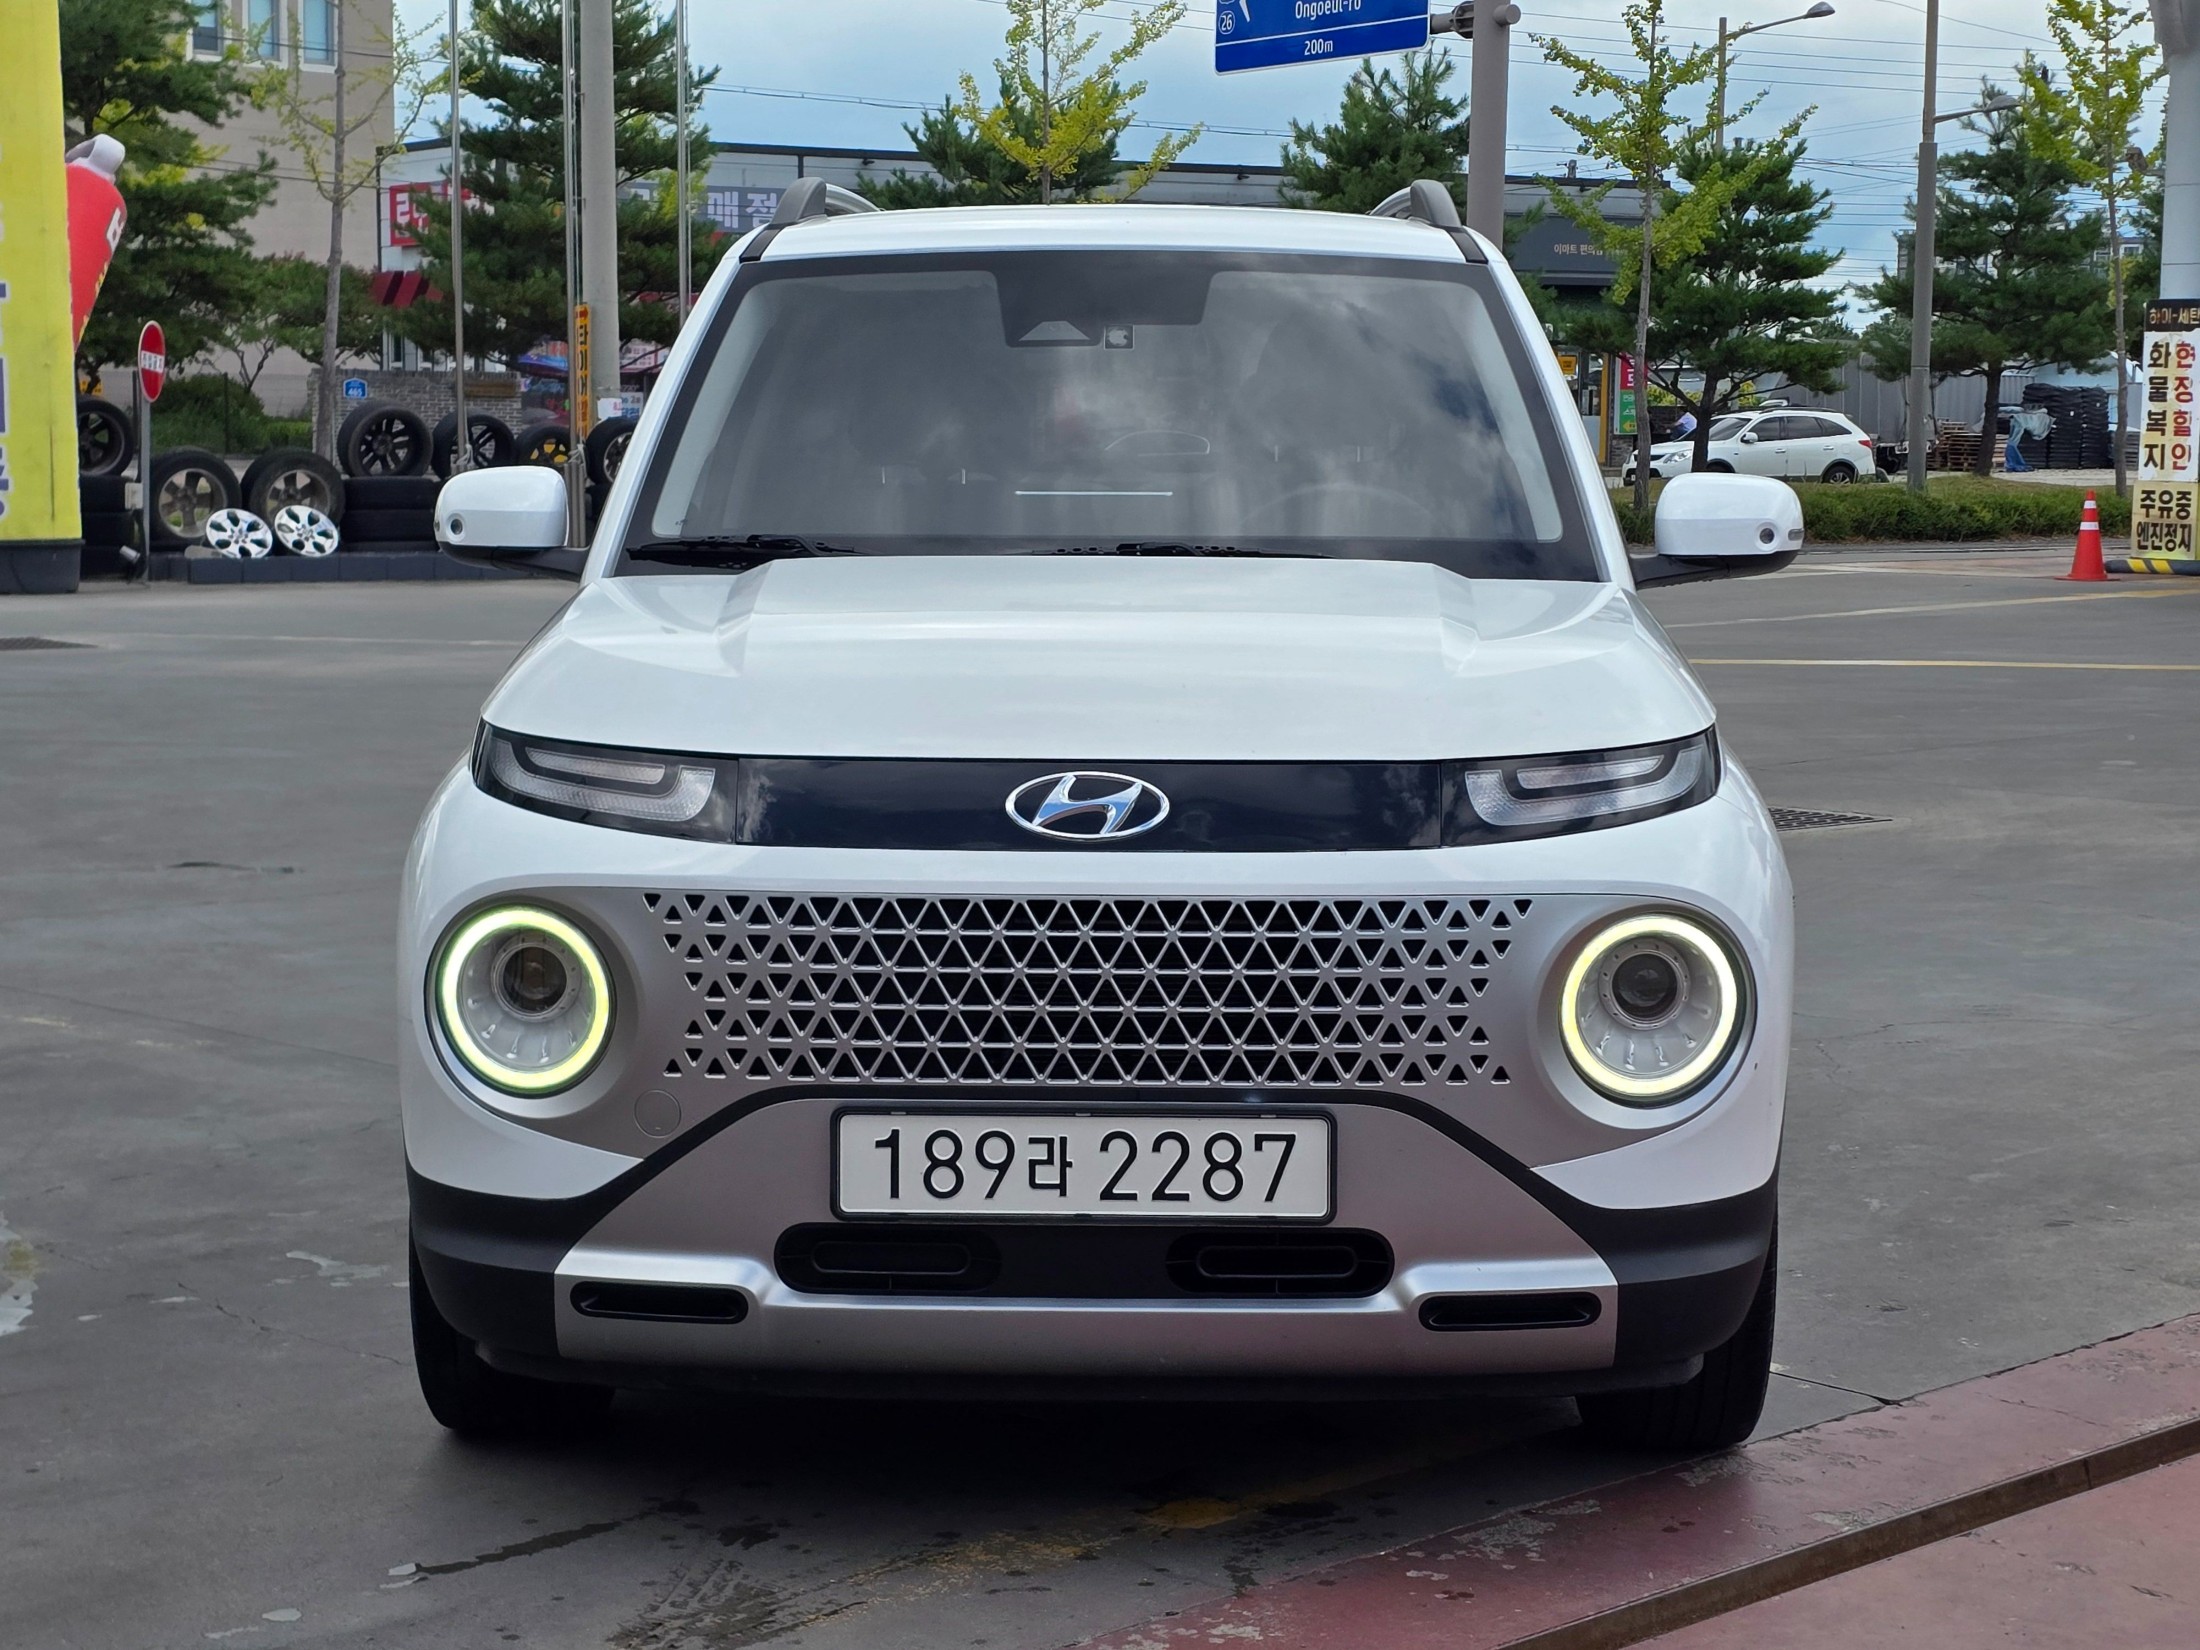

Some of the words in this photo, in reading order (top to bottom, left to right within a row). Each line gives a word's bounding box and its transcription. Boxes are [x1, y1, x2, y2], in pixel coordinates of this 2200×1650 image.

[1221, 14, 1233, 31] 26
[1295, 0, 1361, 21] Ongoeul-ro
[1303, 38, 1334, 56] 200m
[1553, 243, 1578, 255] 이마트
[2143, 341, 2172, 471] 화물복지
[2140, 489, 2192, 520] 주유중
[2136, 521, 2192, 553] 엔진정지
[874, 1126, 1074, 1200] 189라
[1098, 1130, 1298, 1203] 2287
